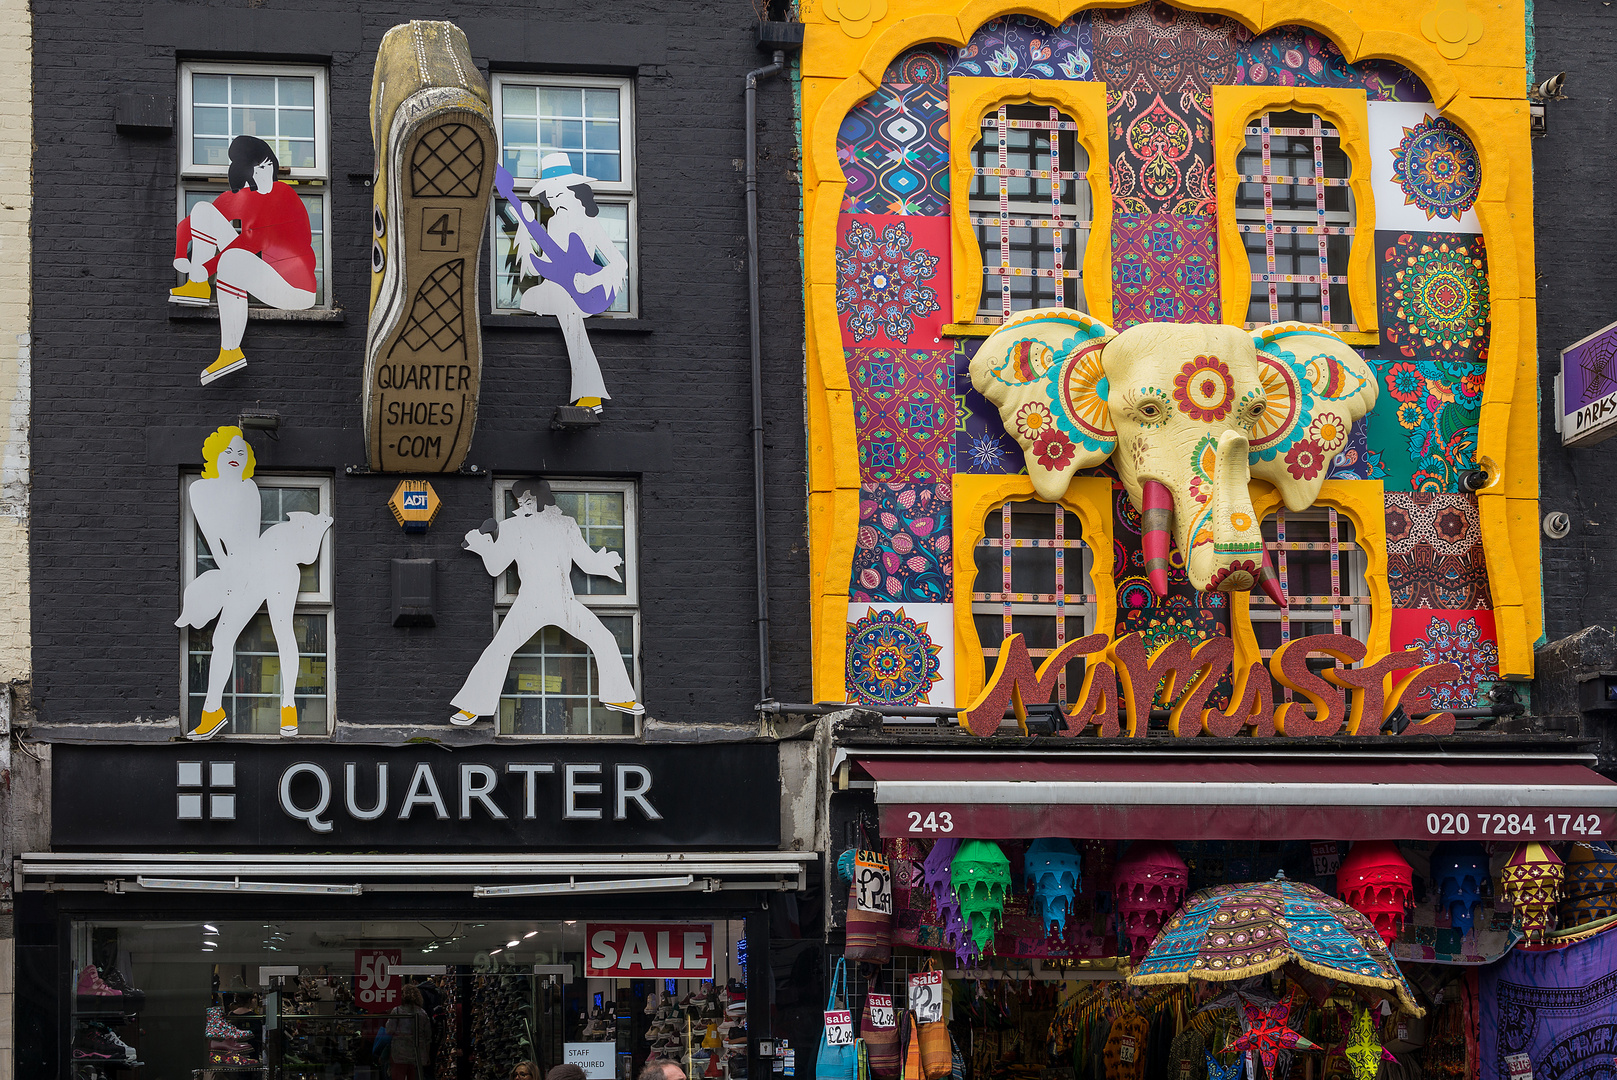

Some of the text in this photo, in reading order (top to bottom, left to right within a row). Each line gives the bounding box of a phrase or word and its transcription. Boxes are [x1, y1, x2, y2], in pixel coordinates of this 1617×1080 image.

[426, 213, 455, 247] 4
[378, 364, 471, 391] QUARTER
[387, 401, 454, 425] SHOES
[404, 494, 428, 506] ADT
[277, 761, 664, 834] QUARTER
[907, 811, 954, 832] 243
[1426, 812, 1602, 835] 020 7284 1742
[858, 850, 888, 865] SALE
[1312, 844, 1336, 855] sale
[591, 930, 709, 970] SALE
[912, 974, 939, 986] sale
[360, 990, 396, 1003] OFF
[869, 997, 892, 1007] sale
[826, 1013, 851, 1024] sale
[828, 1025, 853, 1044] £2.99
[1509, 1058, 1531, 1072] sale
